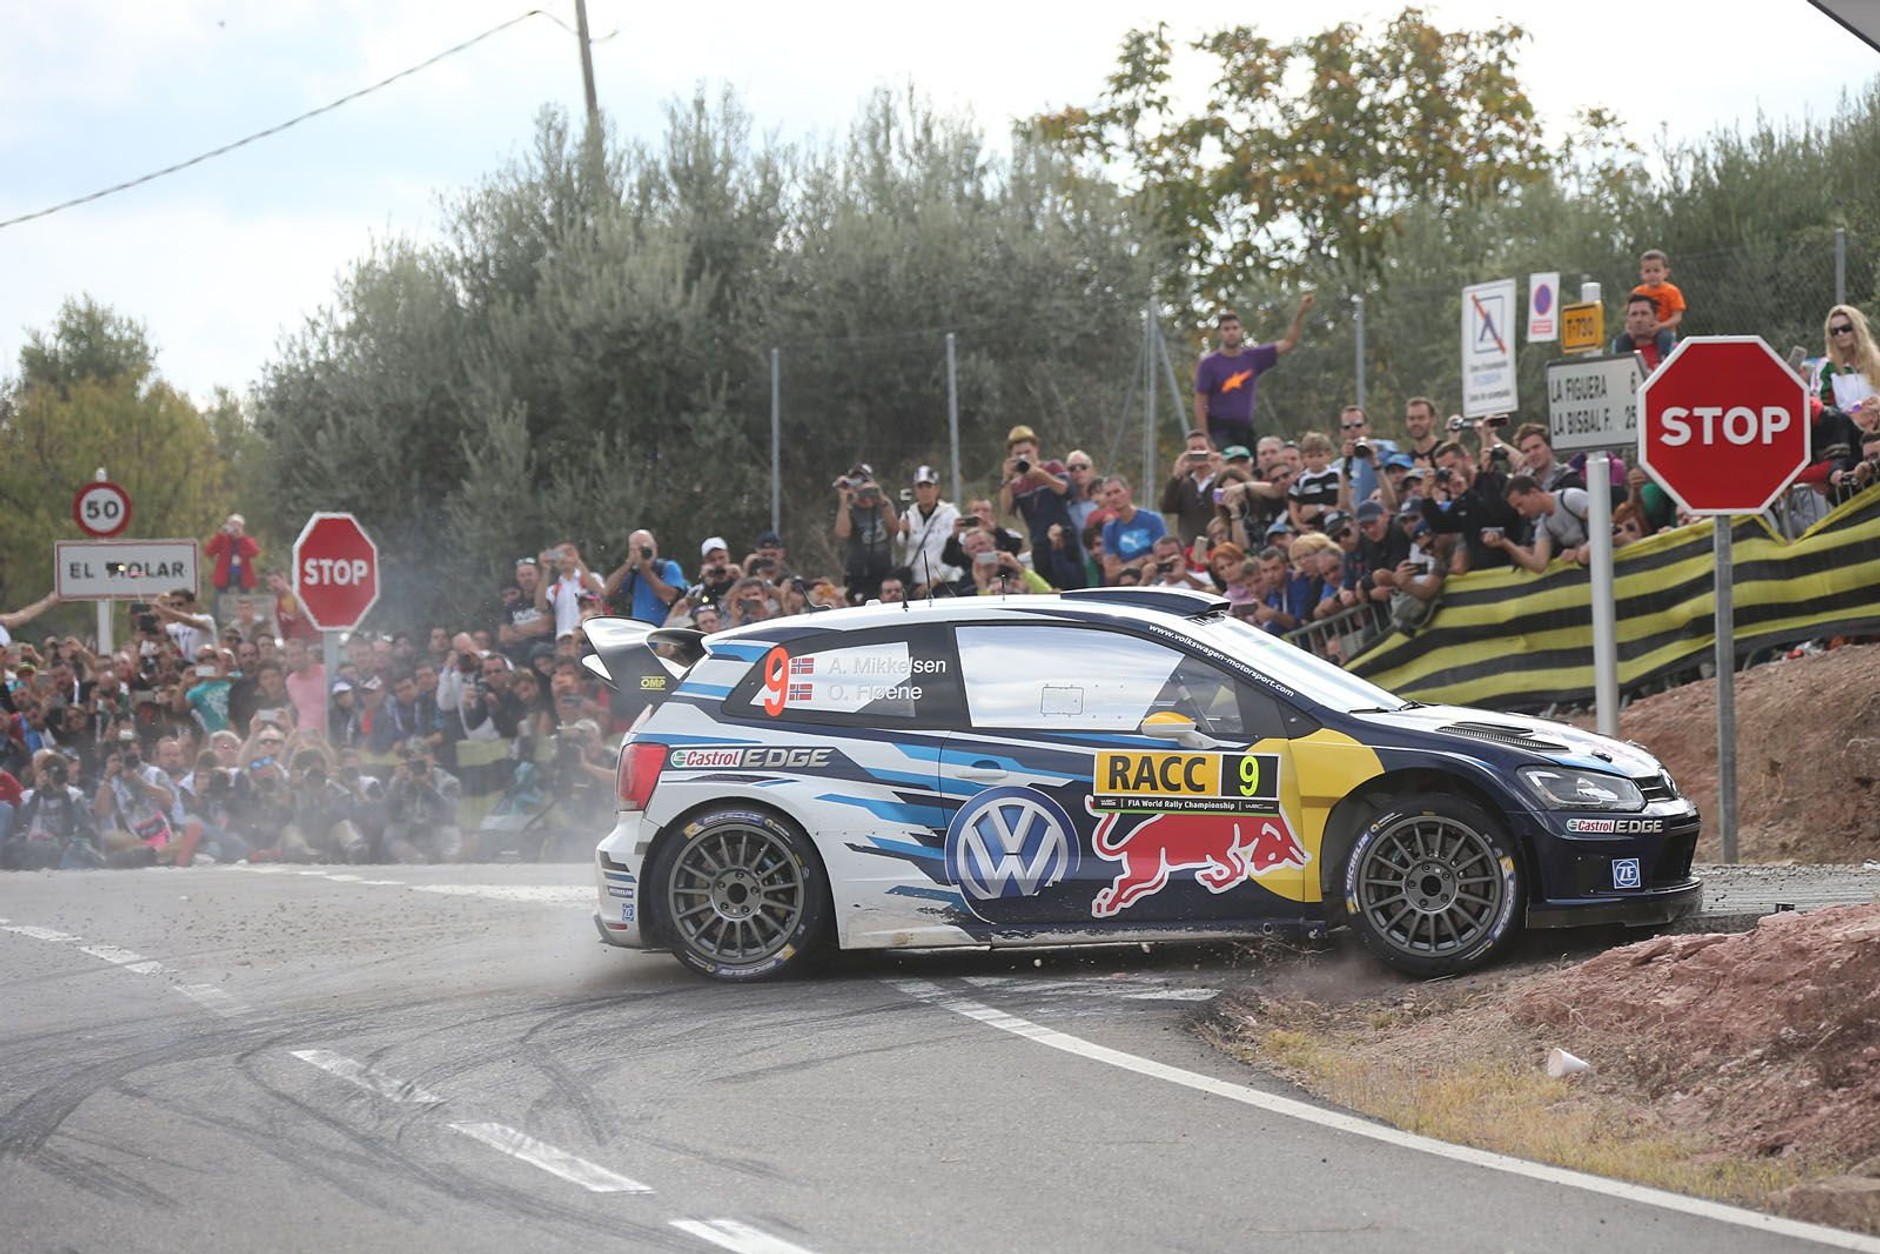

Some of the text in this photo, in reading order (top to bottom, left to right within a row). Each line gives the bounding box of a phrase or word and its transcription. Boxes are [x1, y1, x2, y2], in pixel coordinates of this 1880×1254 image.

[1551, 371, 1637, 403] LA FIGUERA 6
[1553, 411, 1565, 436] LA
[1567, 408, 1601, 435] BISBAL
[1625, 405, 1637, 430] 25
[1659, 405, 1791, 447] STOP
[86, 500, 119, 519] 50
[69, 562, 95, 579] EL
[304, 558, 368, 586] STOP
[828, 656, 946, 675] A. Mikkelsen
[1148, 624, 1295, 698] www.volkswagen-motorsport.com
[641, 679, 666, 688] OMP
[763, 646, 789, 717] 9
[828, 685, 849, 701] O.
[687, 748, 831, 768] Castrol EDGE
[1109, 755, 1206, 793] RACC
[1239, 755, 1259, 797] 9
[1141, 800, 1163, 808] World
[1164, 801, 1183, 809] Rally
[1184, 801, 1235, 810] Championship
[1578, 820, 1664, 834] Castrol EDGE
[1345, 833, 1369, 891] MICHELIN
